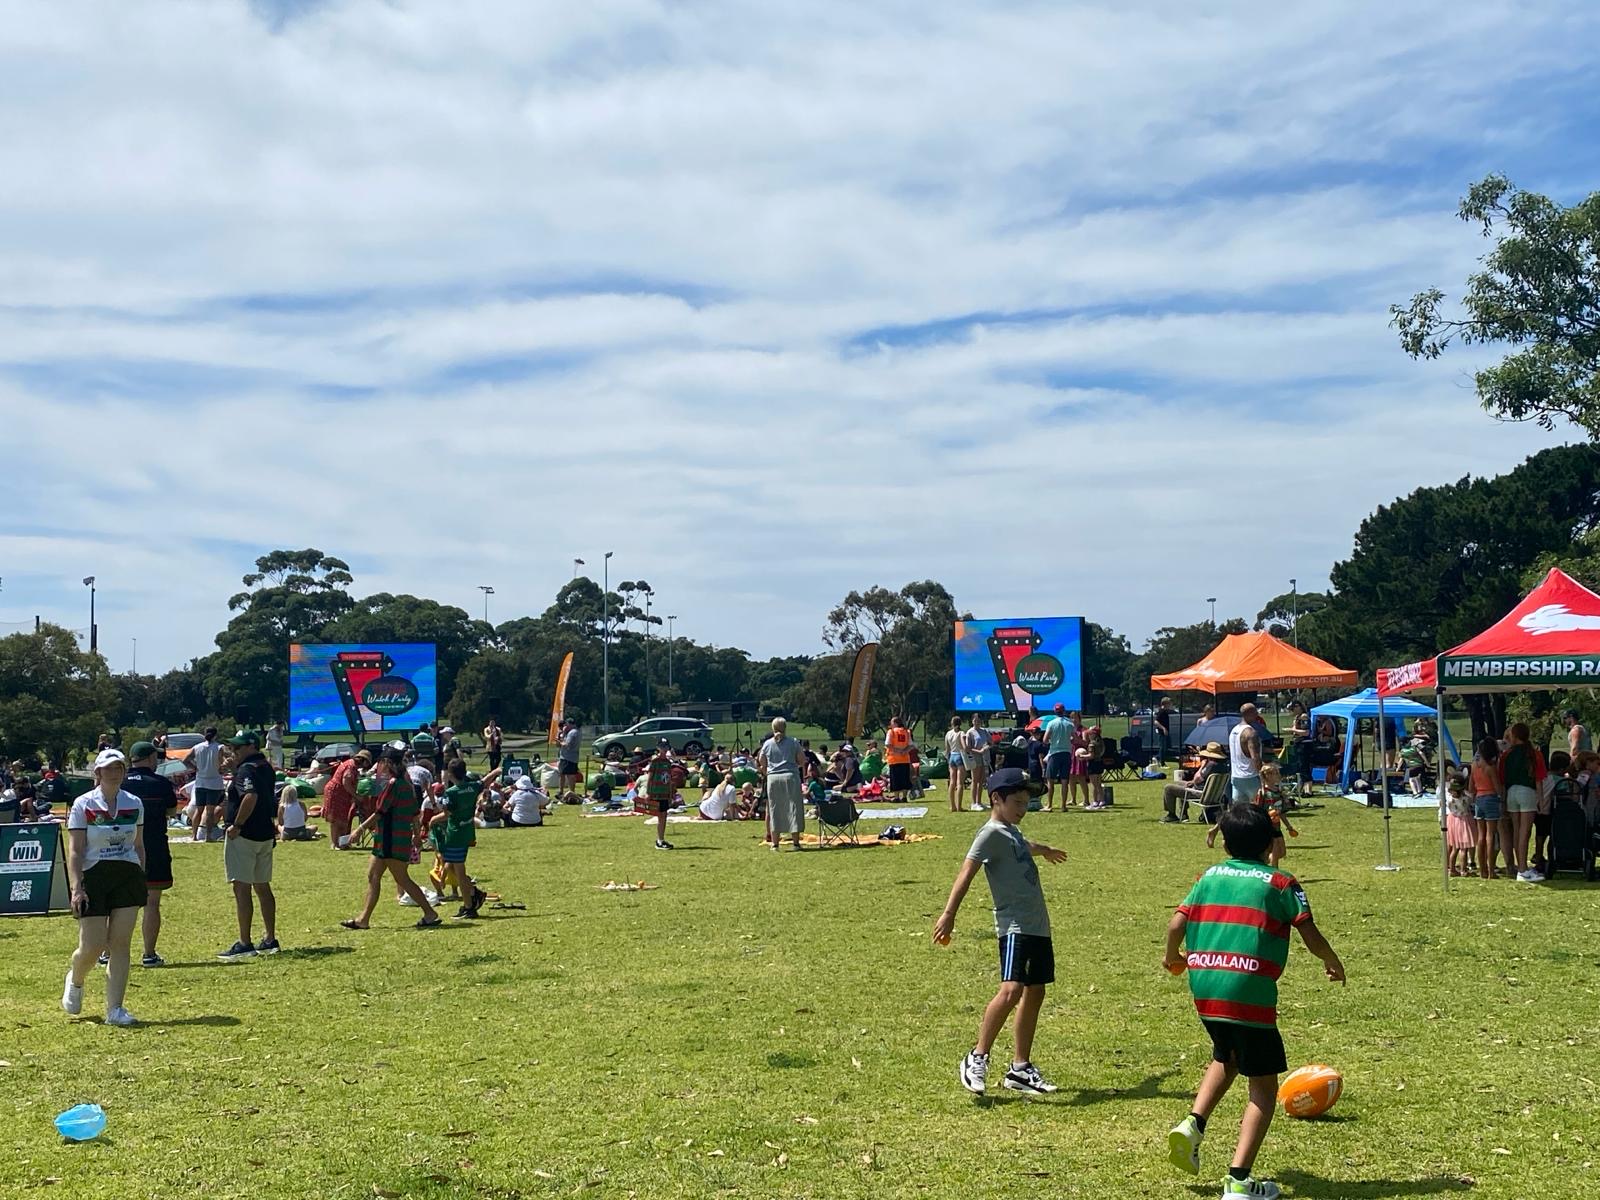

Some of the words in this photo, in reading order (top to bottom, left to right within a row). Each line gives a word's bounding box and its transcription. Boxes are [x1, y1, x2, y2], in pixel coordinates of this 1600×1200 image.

[1019, 671, 1039, 682] Watch
[1039, 671, 1058, 684] Party
[1233, 675, 1343, 689] ingeniaholidays.com.au
[13, 846, 39, 860] WIN
[1216, 865, 1273, 883] Menulog
[1194, 953, 1260, 972] AQUALAND
